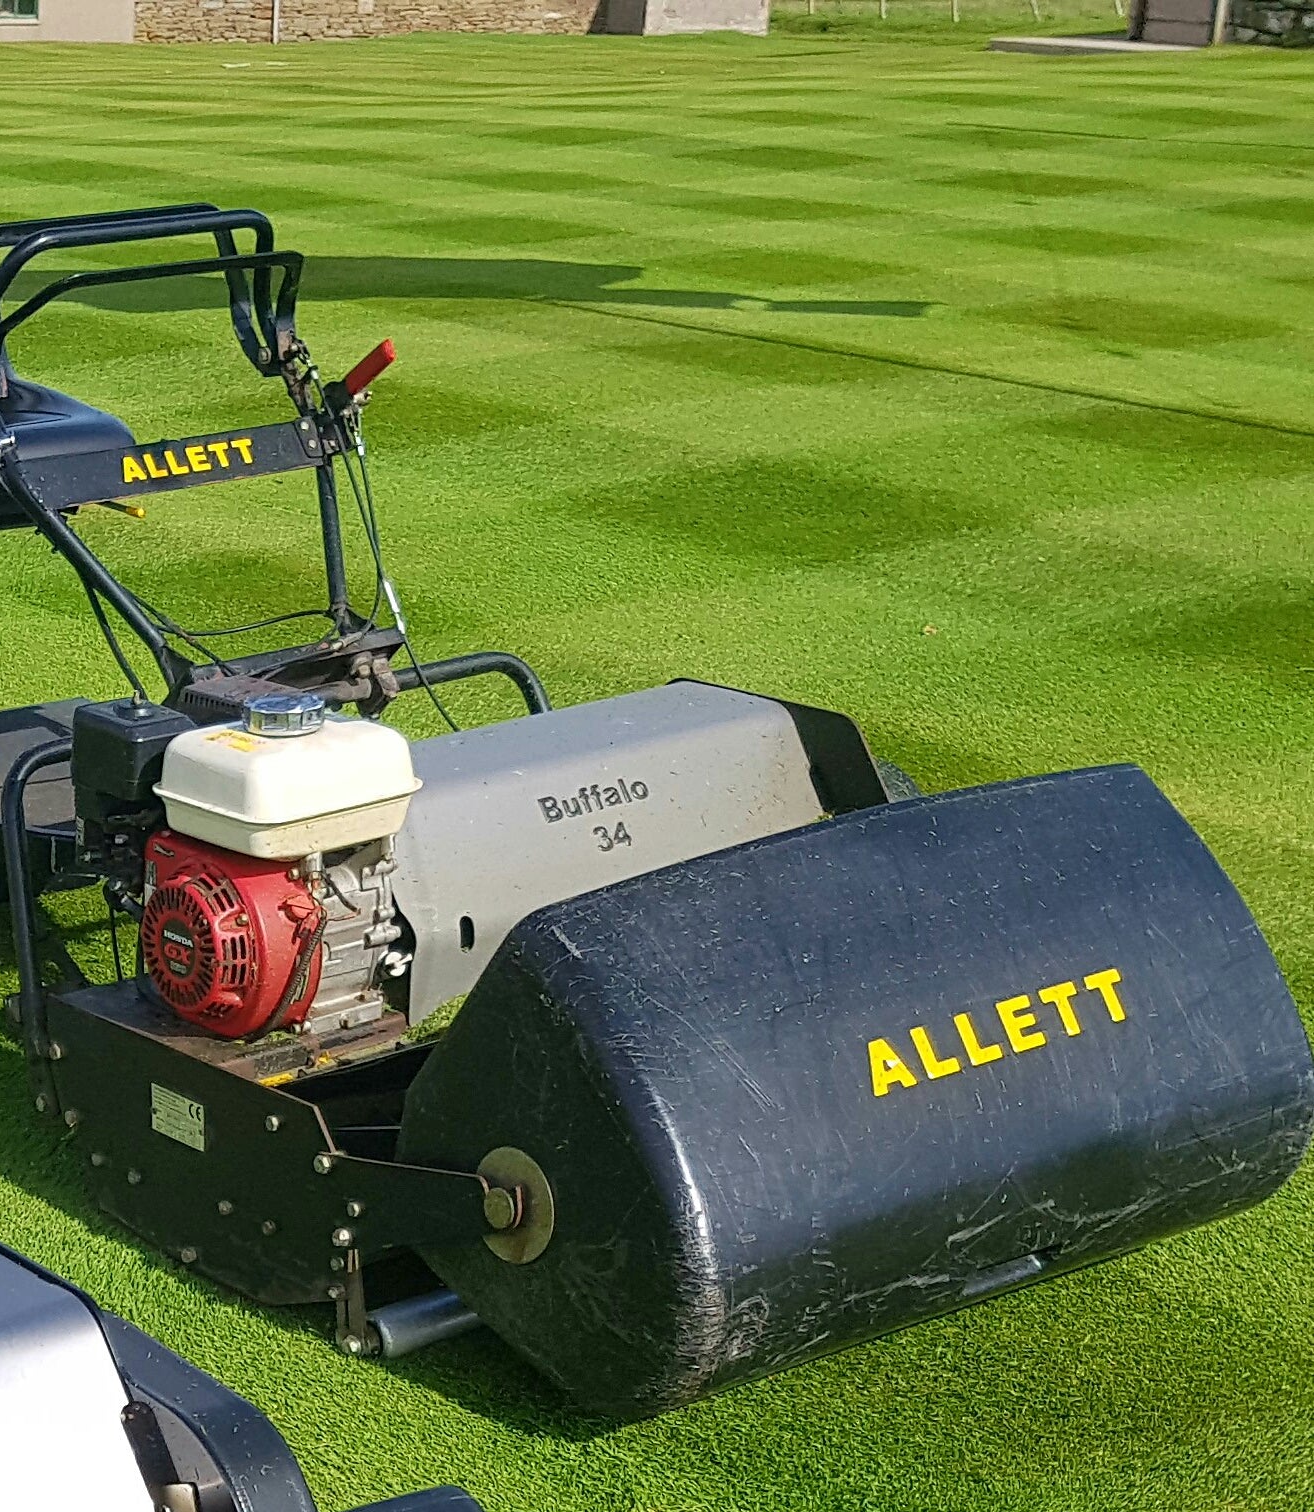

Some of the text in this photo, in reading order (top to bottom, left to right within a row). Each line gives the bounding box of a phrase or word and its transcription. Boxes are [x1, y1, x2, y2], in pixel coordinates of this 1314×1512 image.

[122, 437, 253, 483] ALLETT
[537, 778, 649, 824] Buffalo
[592, 821, 633, 852] 34
[867, 968, 1126, 1097] ALLETT
